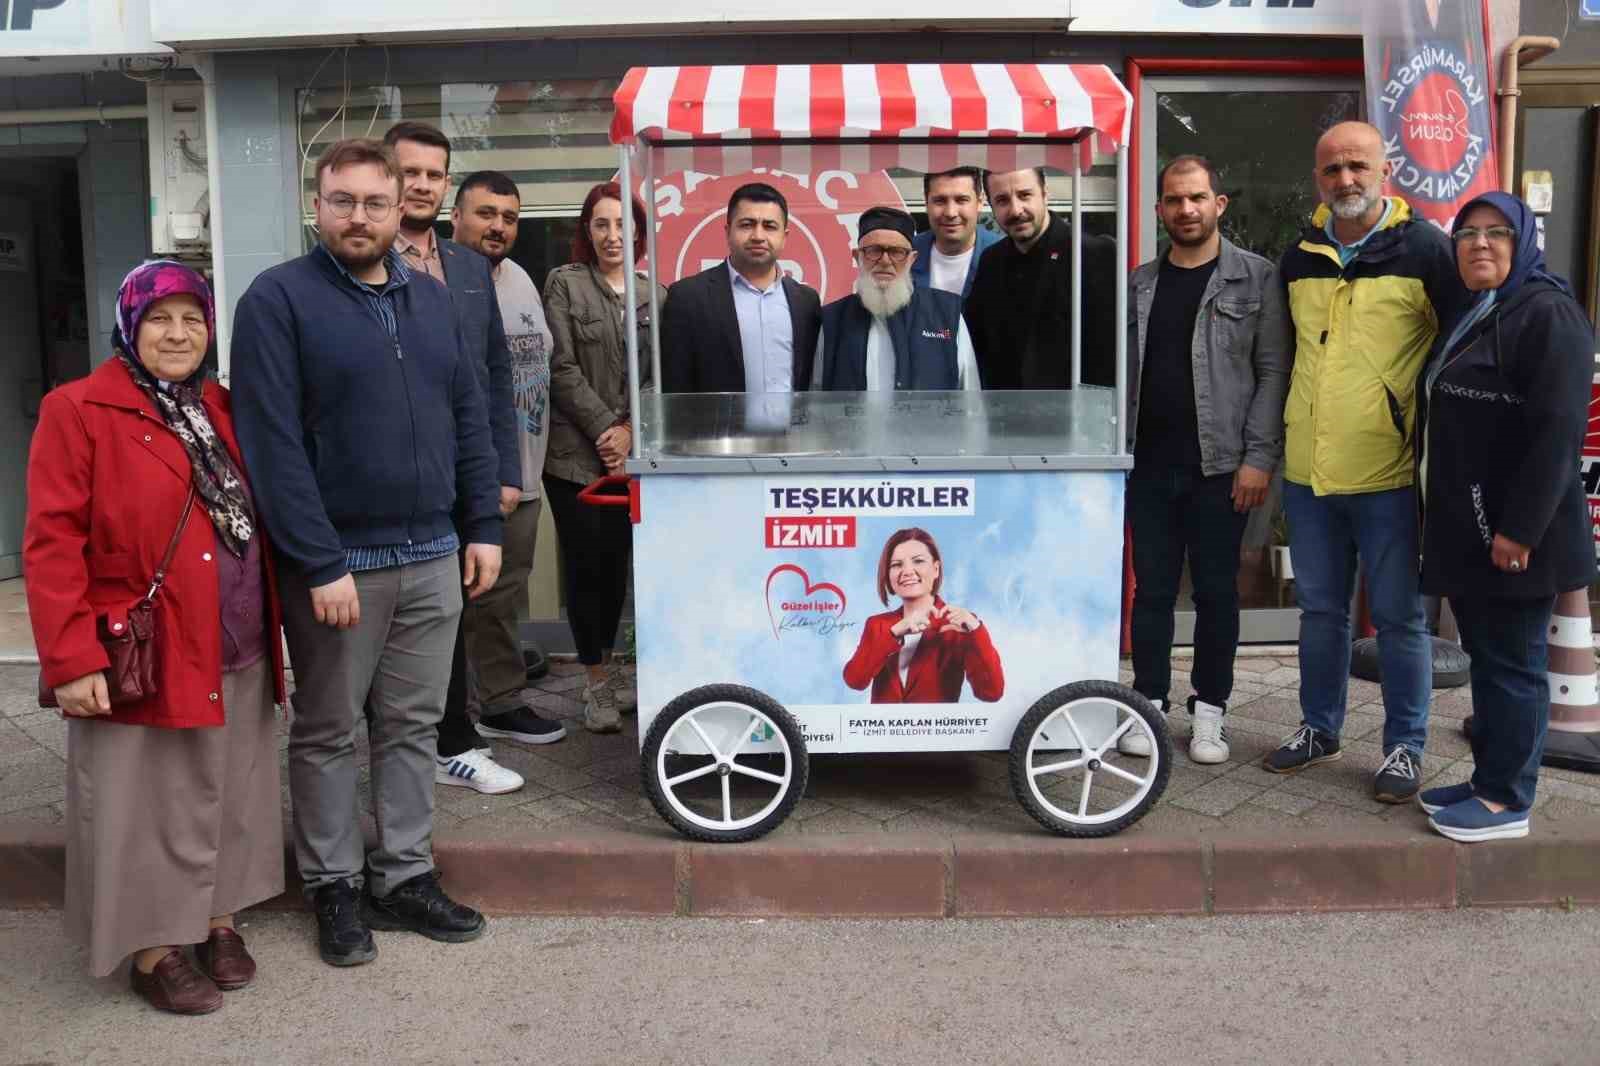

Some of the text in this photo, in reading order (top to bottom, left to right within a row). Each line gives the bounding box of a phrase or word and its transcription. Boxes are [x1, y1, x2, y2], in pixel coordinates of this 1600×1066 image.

[770, 481, 969, 514] TEŞEKKÜRLER
[772, 519, 848, 546] İZMİT
[781, 601, 812, 611] Güzel
[849, 717, 989, 727] FATMA KAPLAN HÜRRİYET
[889, 728, 932, 736] BELEDİYE
[801, 733, 834, 742] DİYESİ
